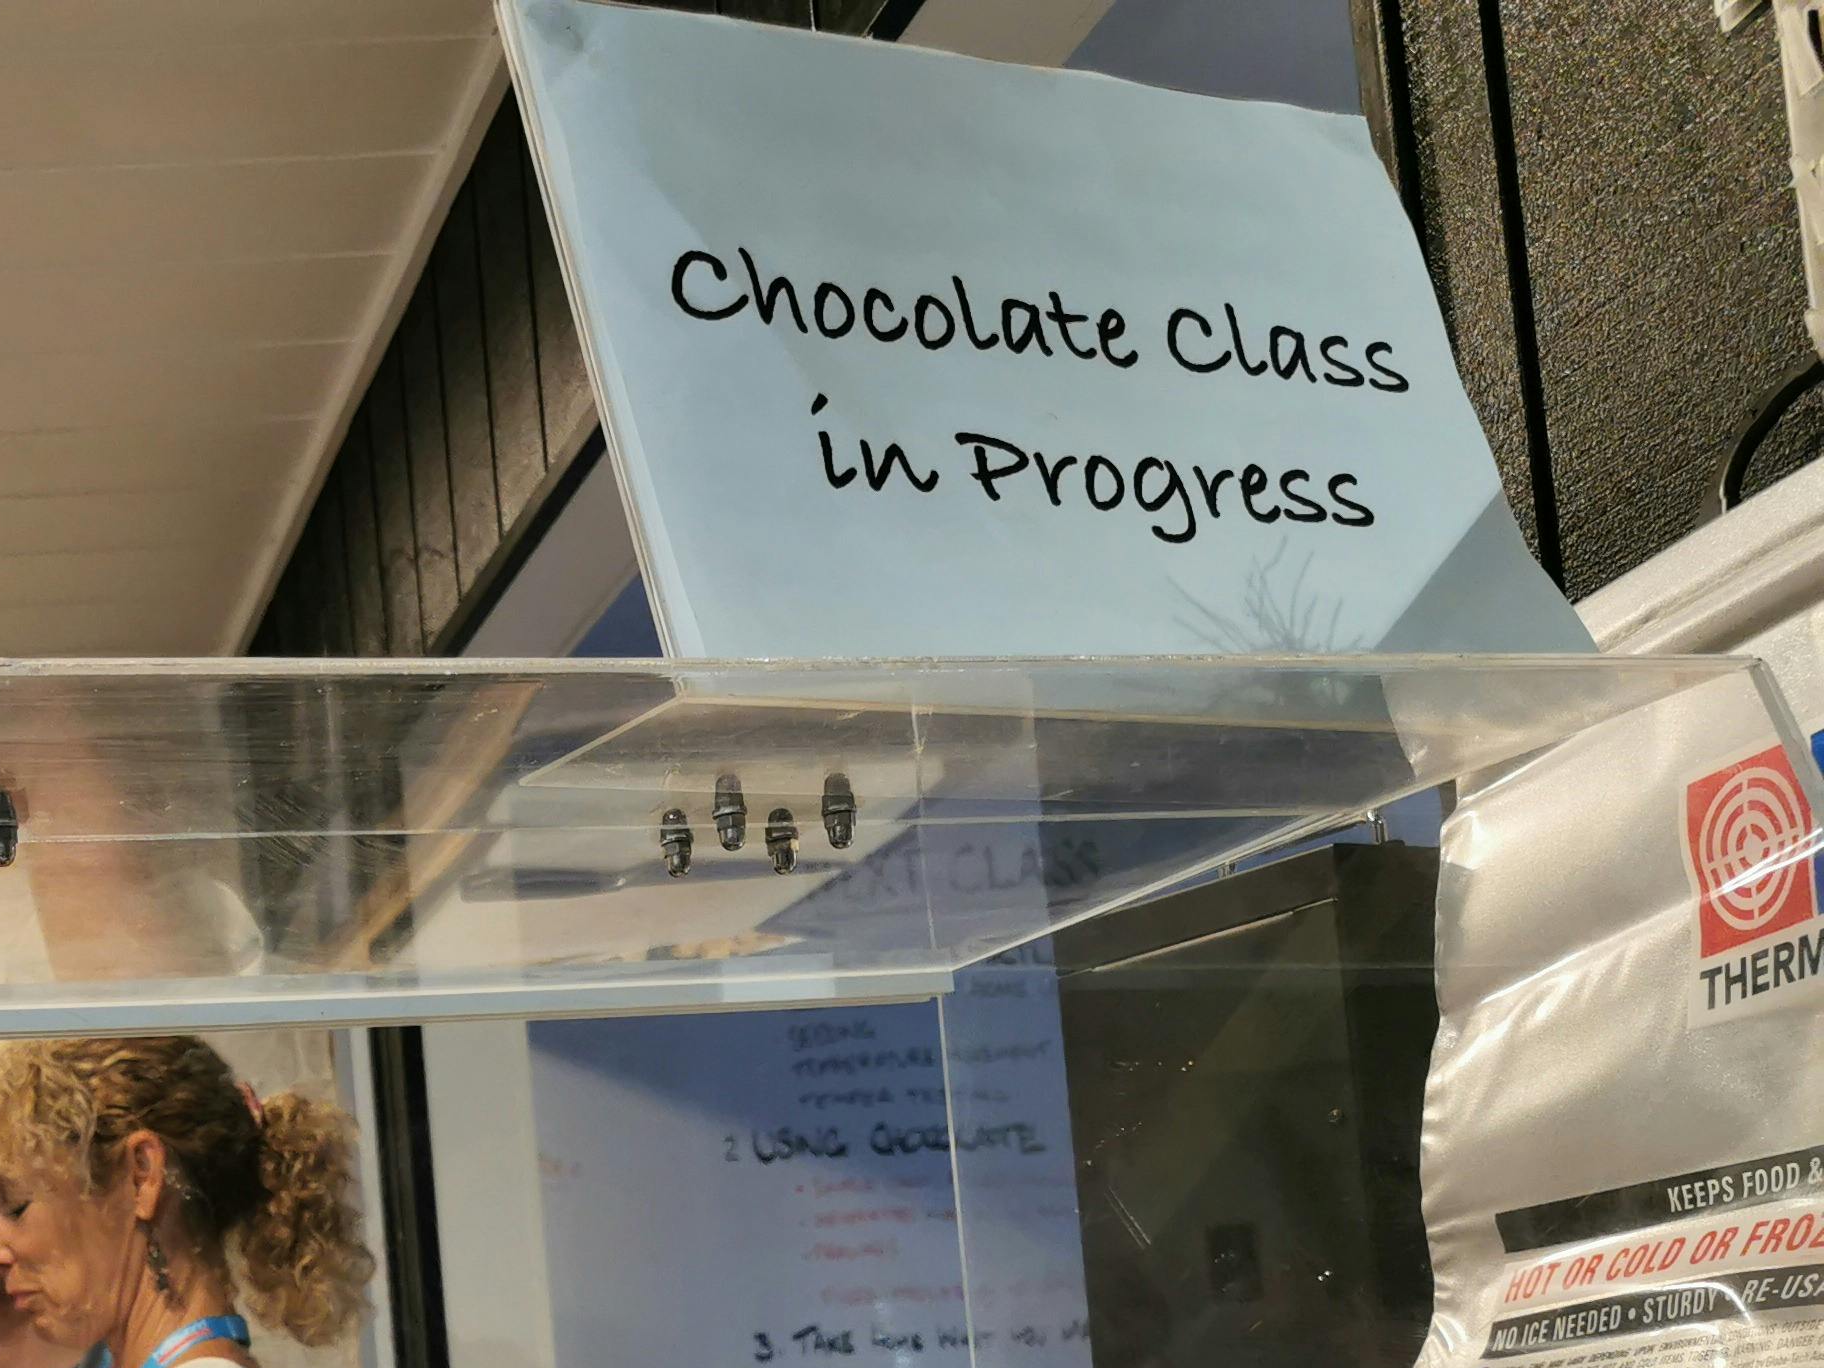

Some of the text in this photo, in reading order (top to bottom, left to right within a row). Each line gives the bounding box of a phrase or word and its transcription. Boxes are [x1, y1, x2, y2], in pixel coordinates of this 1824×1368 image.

[671, 248, 1409, 392] Chocolate Class
[810, 394, 1374, 542] in Progress
[1667, 1157, 1824, 1213] KEEPS FOOD &
[1504, 1262, 1561, 1303] HOT
[1562, 1253, 1603, 1291] OR
[1606, 1243, 1687, 1281] COLD
[1689, 1226, 1739, 1265] OR
[1492, 1328, 1518, 1352] NO
[1521, 1320, 1550, 1347] ICE
[1552, 1304, 1622, 1342] NEEDED
[1642, 1288, 1717, 1325] STURDY
